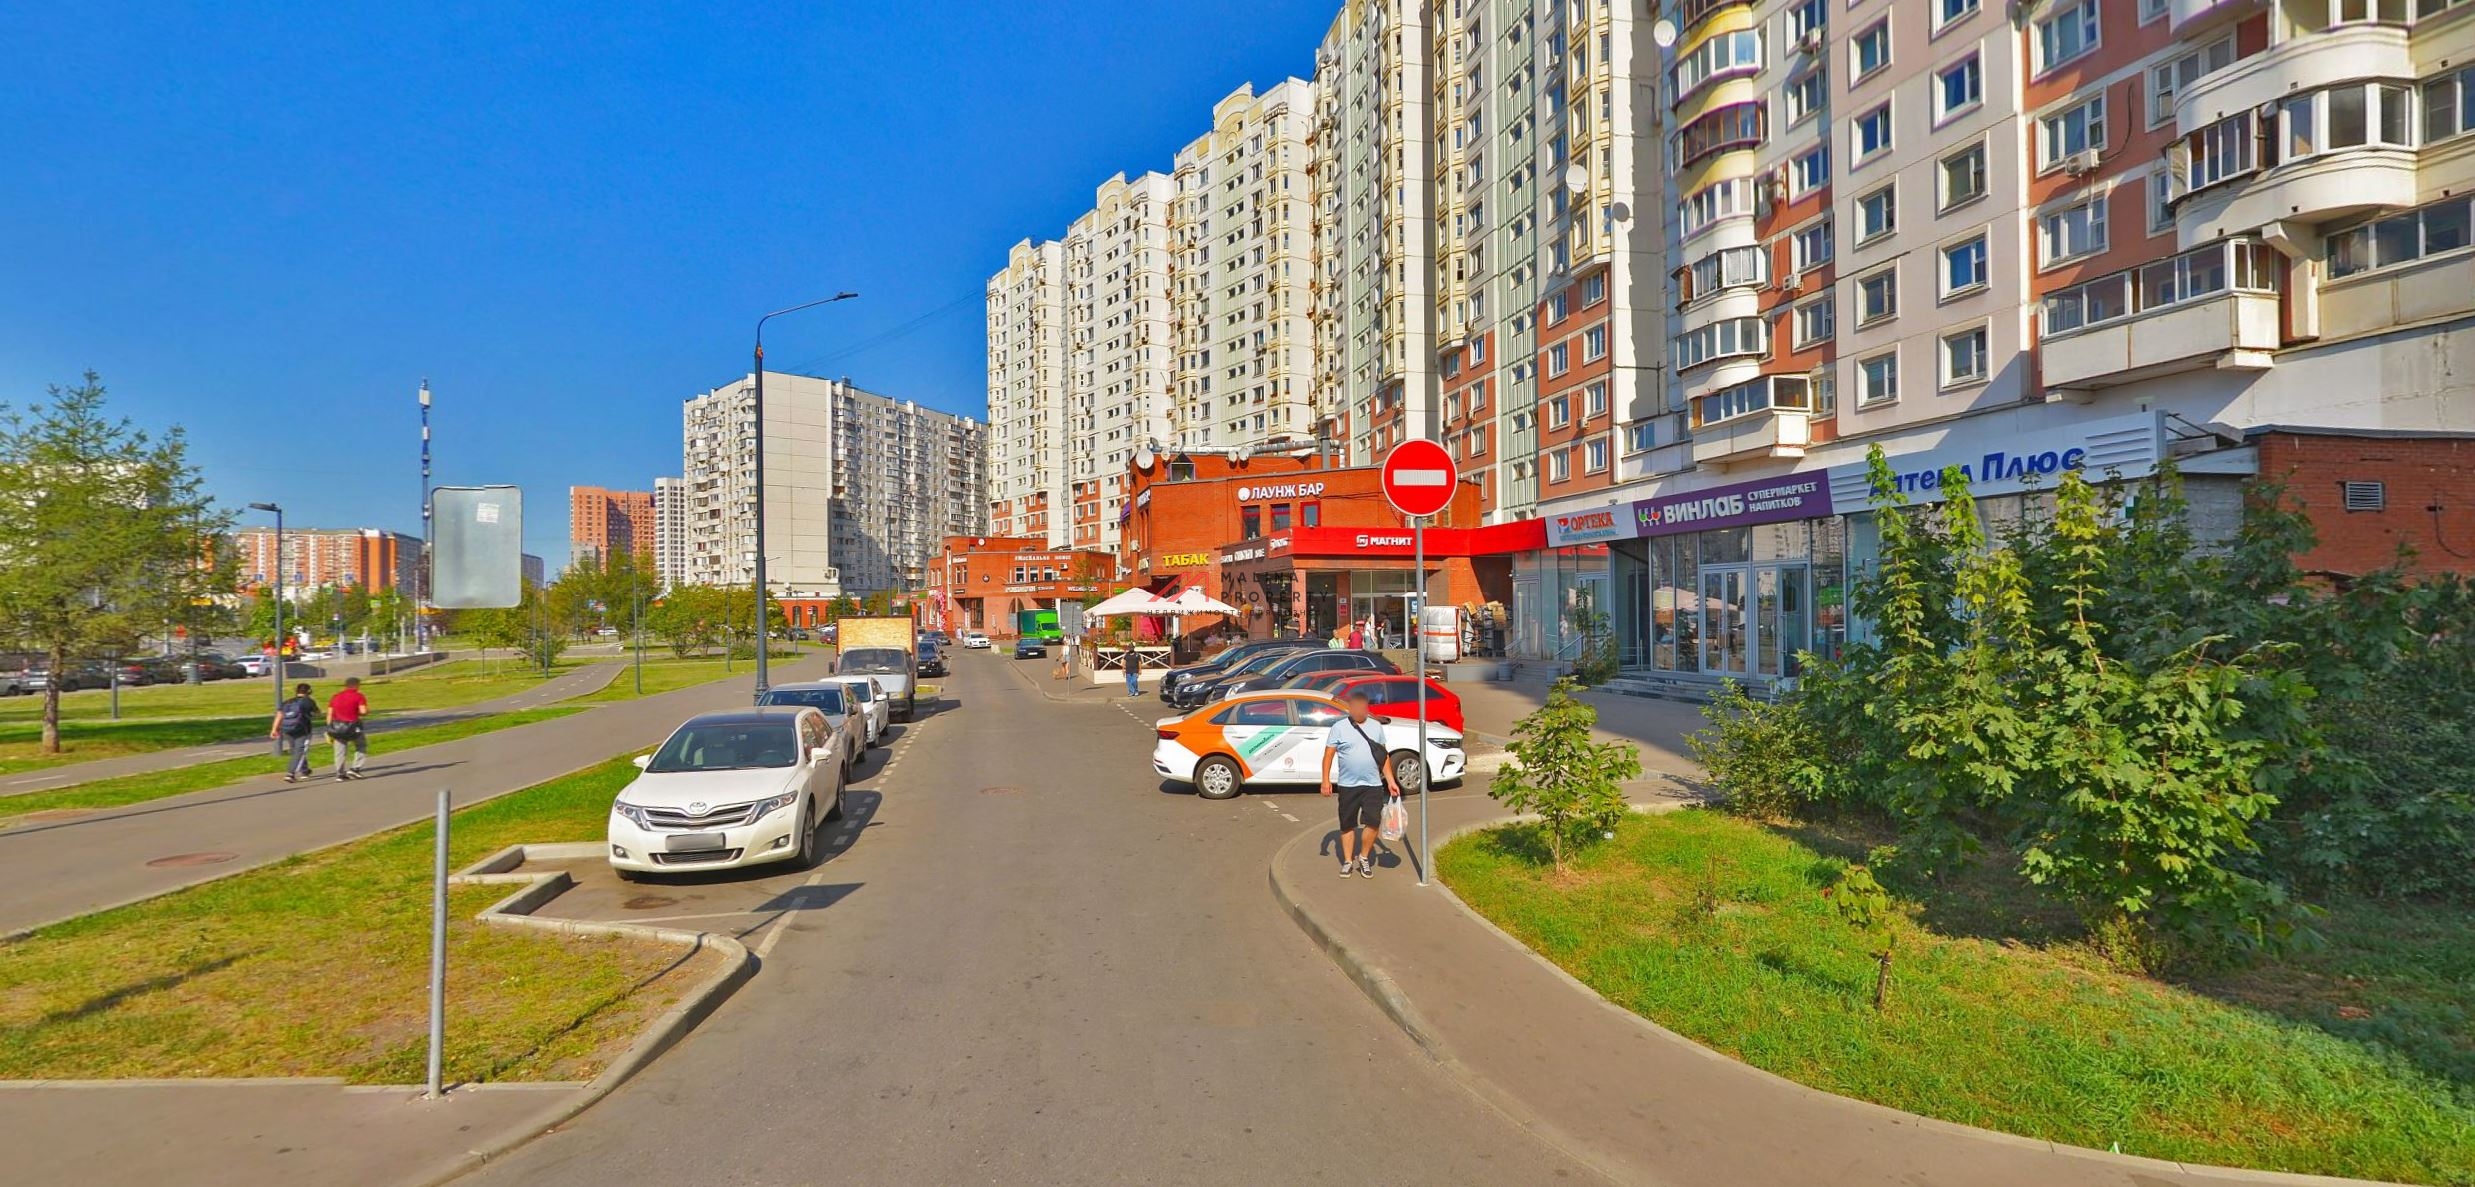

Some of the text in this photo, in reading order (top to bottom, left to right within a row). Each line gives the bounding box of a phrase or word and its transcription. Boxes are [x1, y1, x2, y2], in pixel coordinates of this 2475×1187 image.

[1981, 448, 2085, 481] Плюс
[1251, 482, 1324, 499] ЛАУНЖ БАР
[1747, 482, 1817, 501] СУПЕРМАРКЕТ
[1749, 497, 1802, 513] НАПИТКОВ
[1570, 511, 1615, 531] ОРТЕКА
[1370, 537, 1413, 546] МАГНИТ
[1162, 553, 1210, 567] ТАБАК
